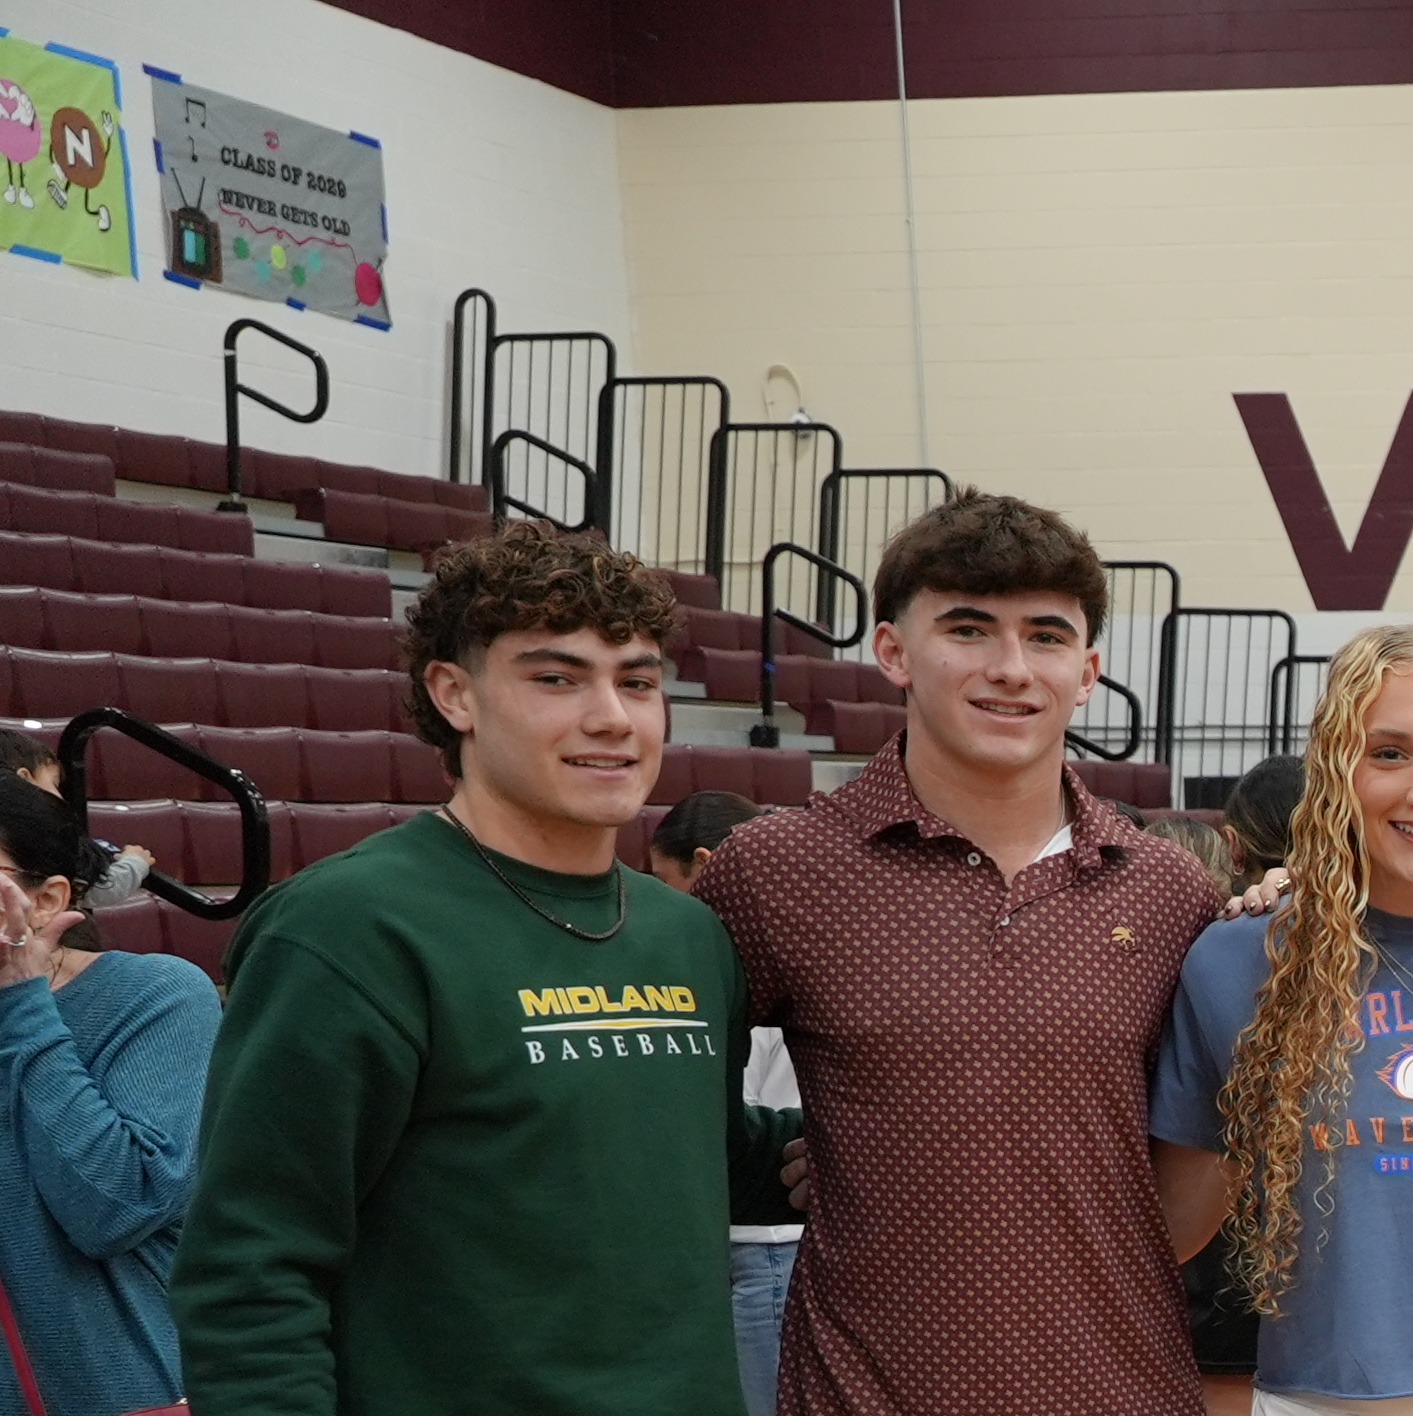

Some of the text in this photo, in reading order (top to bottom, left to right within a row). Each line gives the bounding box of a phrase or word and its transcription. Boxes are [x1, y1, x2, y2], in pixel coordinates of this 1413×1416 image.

[64, 121, 94, 168] N
[221, 145, 276, 178] CLASS
[281, 164, 302, 186] OF
[220, 188, 351, 237] NEVER GETS OLD
[518, 985, 698, 1017] MIDLAND
[525, 1032, 717, 1065] BASEBALL
